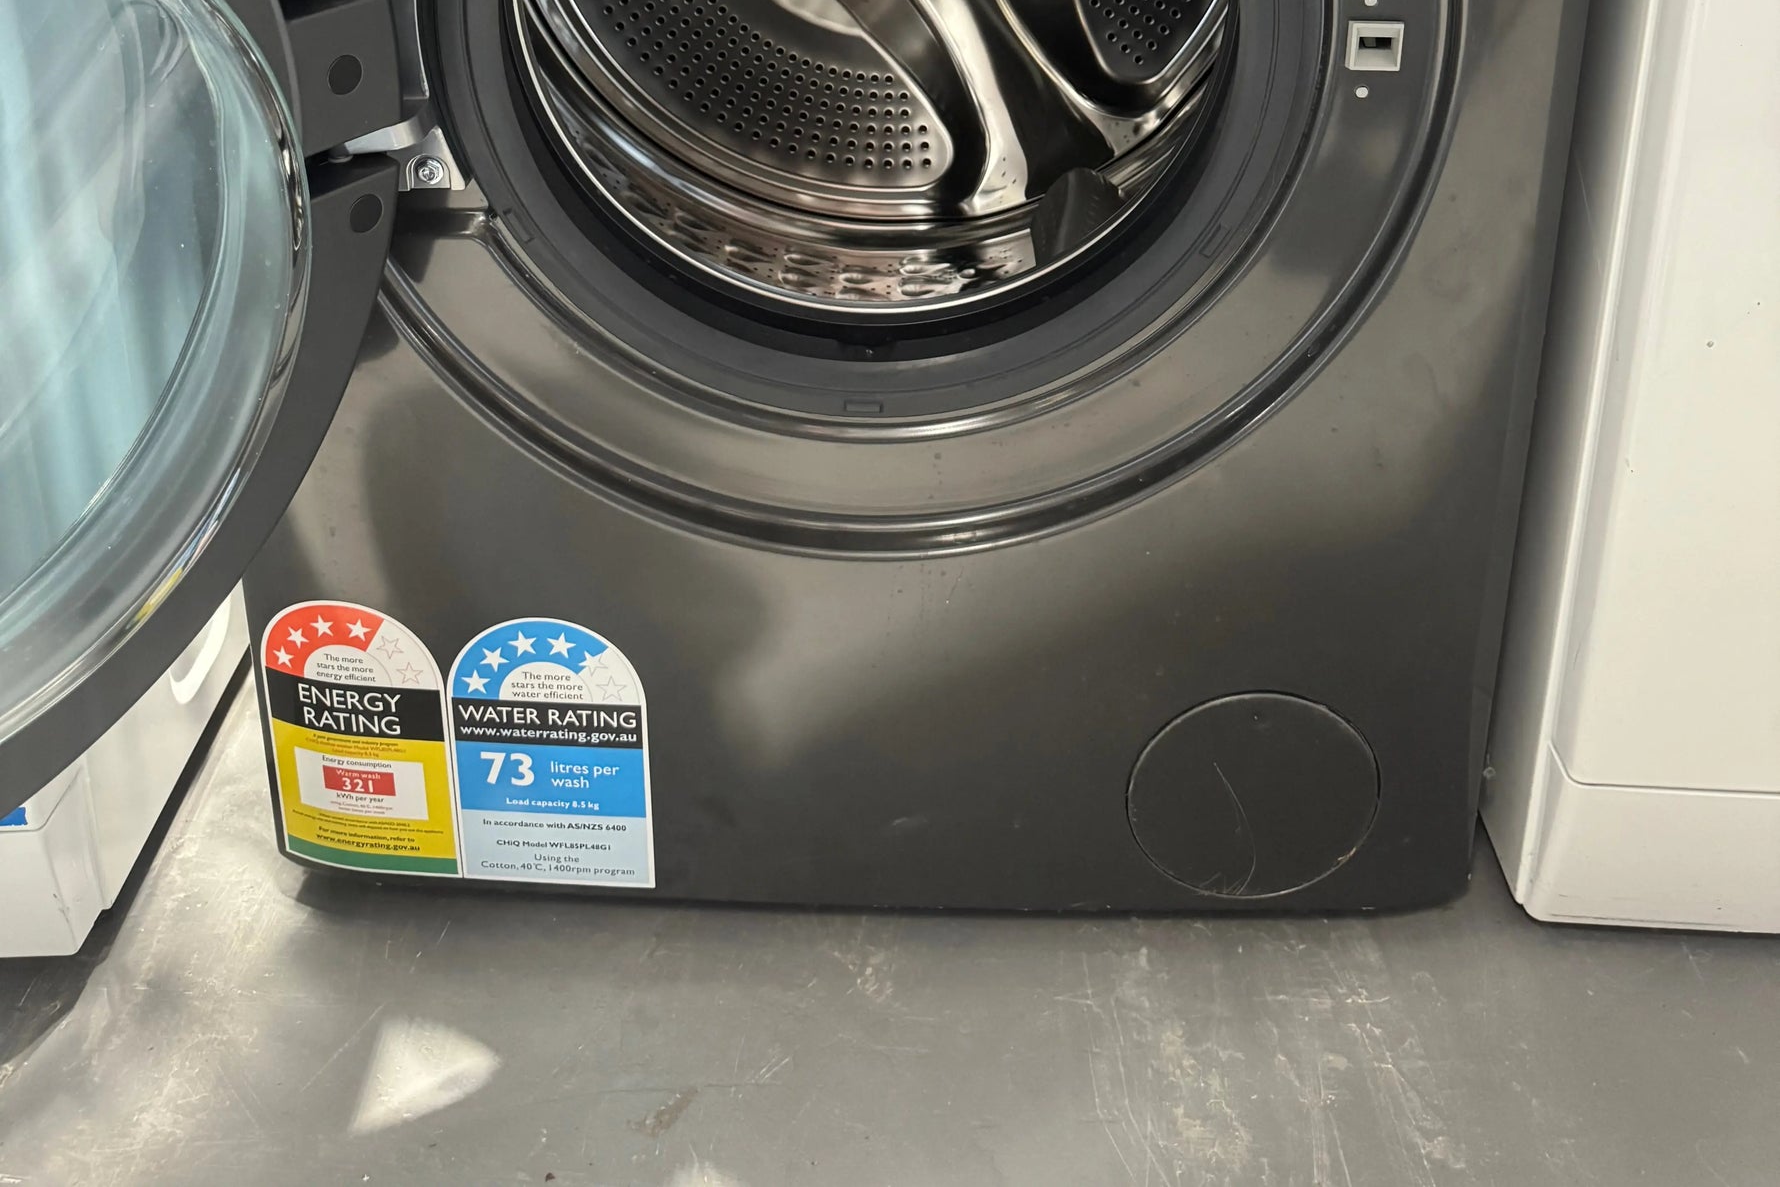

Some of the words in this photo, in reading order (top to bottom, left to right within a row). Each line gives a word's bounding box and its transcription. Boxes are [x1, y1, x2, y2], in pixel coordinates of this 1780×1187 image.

[324, 653, 340, 662] The
[316, 662, 335, 670] stars
[337, 664, 350, 672] the
[352, 666, 374, 674] more
[316, 671, 342, 681] energy
[344, 674, 376, 682] efficient
[522, 672, 542, 680] The
[538, 682, 554, 690] the
[298, 682, 401, 712] ENERGY
[544, 691, 584, 700] efficient
[303, 706, 401, 735] RATING
[458, 704, 540, 725] WATER
[548, 708, 637, 728] RATING
[460, 725, 637, 743] www.waterrating.gov.au
[322, 755, 345, 765] Energy
[346, 760, 392, 769] consumption
[336, 769, 360, 778] Warm
[362, 772, 381, 780] wash
[480, 751, 535, 786] 73
[550, 760, 589, 774] litres
[594, 765, 620, 778] per
[342, 778, 374, 793] 321
[551, 776, 590, 788] wash
[336, 792, 354, 800] kWh
[356, 794, 366, 802] per
[369, 796, 384, 804] year
[532, 800, 570, 809] capacity
[572, 800, 586, 808] 8.5
[588, 802, 600, 810] kg
[494, 818, 544, 828] accordance
[546, 822, 566, 830] with
[567, 823, 603, 831] AS/NZS
[606, 824, 627, 832] 6400
[522, 840, 548, 848] Model
[534, 854, 562, 863] Using
[564, 855, 580, 863] the
[548, 864, 592, 874] 1400rpm
[594, 866, 636, 878] program
